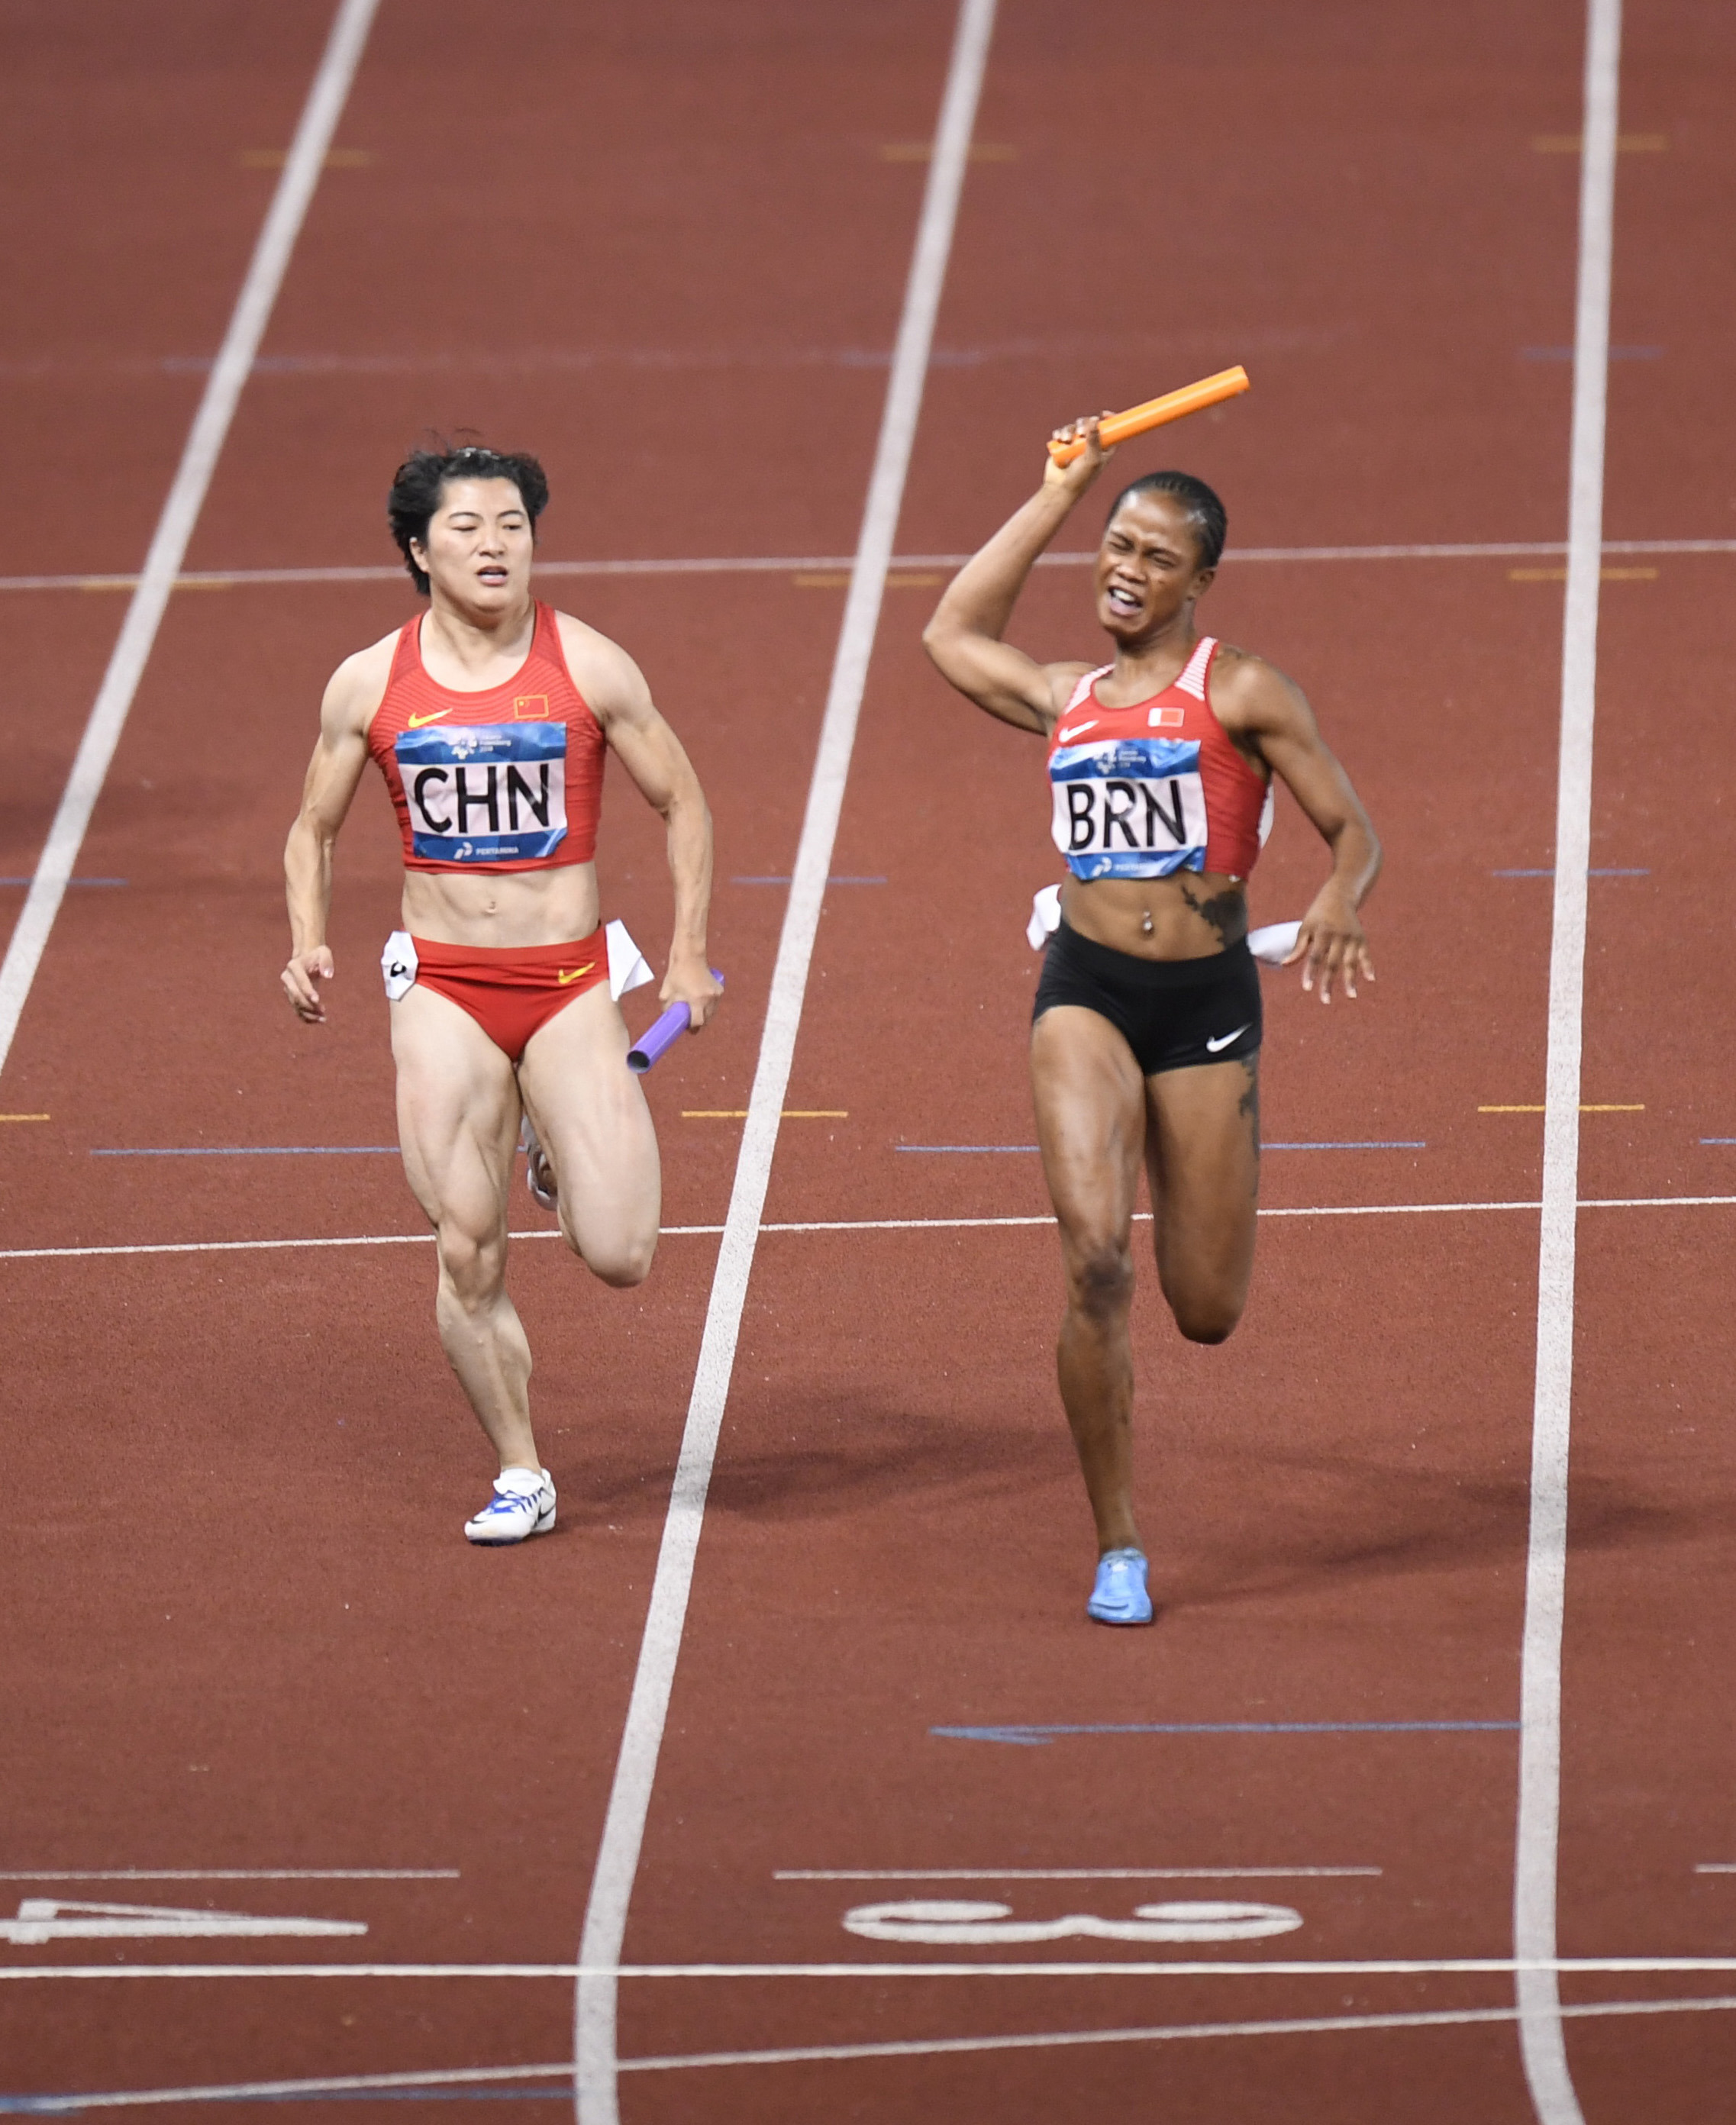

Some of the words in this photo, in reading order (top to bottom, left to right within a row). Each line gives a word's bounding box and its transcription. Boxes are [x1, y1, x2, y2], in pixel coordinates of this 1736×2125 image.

[414, 763, 550, 834] CHN
[1066, 779, 1187, 851] BRN
[0, 1898, 369, 1945] 4
[842, 1899, 1304, 1943] 3
